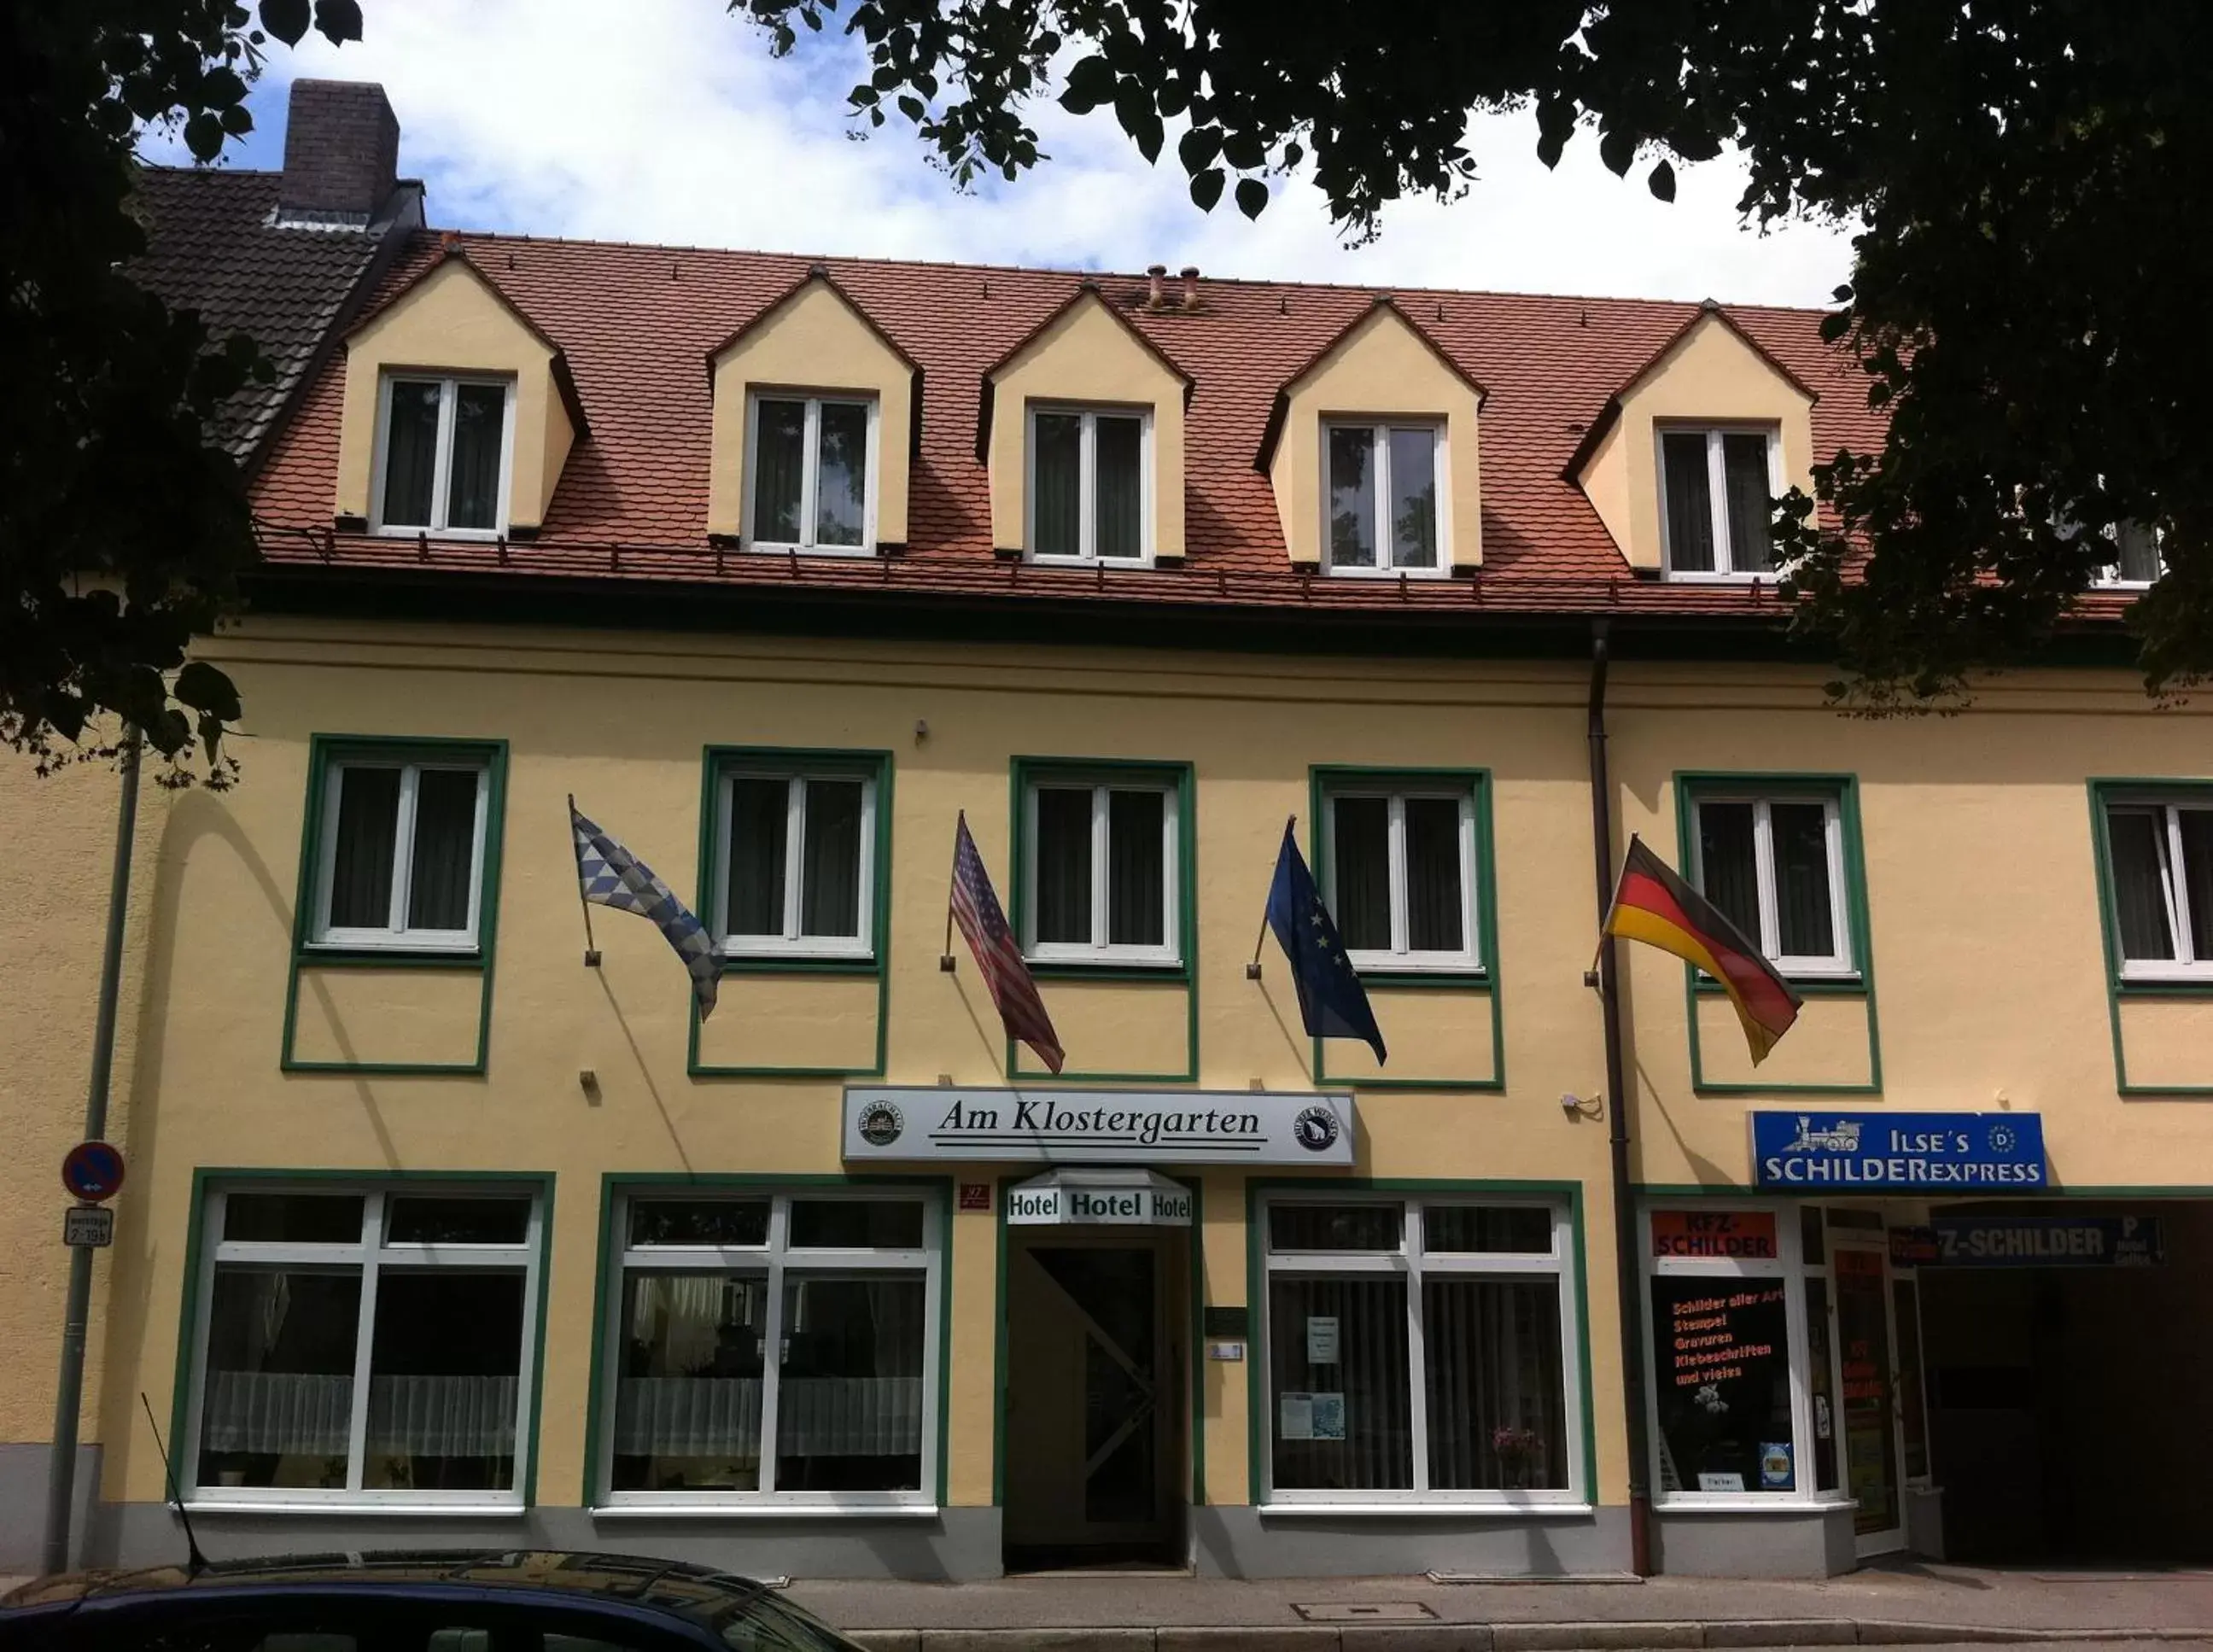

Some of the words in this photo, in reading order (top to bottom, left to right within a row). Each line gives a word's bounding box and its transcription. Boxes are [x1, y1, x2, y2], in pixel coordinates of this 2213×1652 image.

[939, 1100, 997, 1130] Am
[1012, 1100, 1259, 1144] Klostergarten
[1996, 1135, 2007, 1145] D
[1766, 1158, 2041, 1182] SCHILDEREXPRESS
[1010, 1193, 1058, 1216] Hotel
[1071, 1193, 1141, 1217] Hotel
[1153, 1195, 1191, 1217] Hotel
[1687, 1214, 1741, 1233] KFZ-
[2122, 1216, 2139, 1238] P
[1657, 1235, 1775, 1256] SCHILDER
[1936, 1227, 2104, 1258] Z-SCHILDER
[1673, 1298, 1726, 1315] Schilder
[1728, 1292, 1760, 1307] aller
[1673, 1312, 1727, 1333] Stempel
[1674, 1332, 1733, 1350] Gravuren
[1675, 1344, 1772, 1368] Klebeschriften
[1675, 1370, 1699, 1386] und
